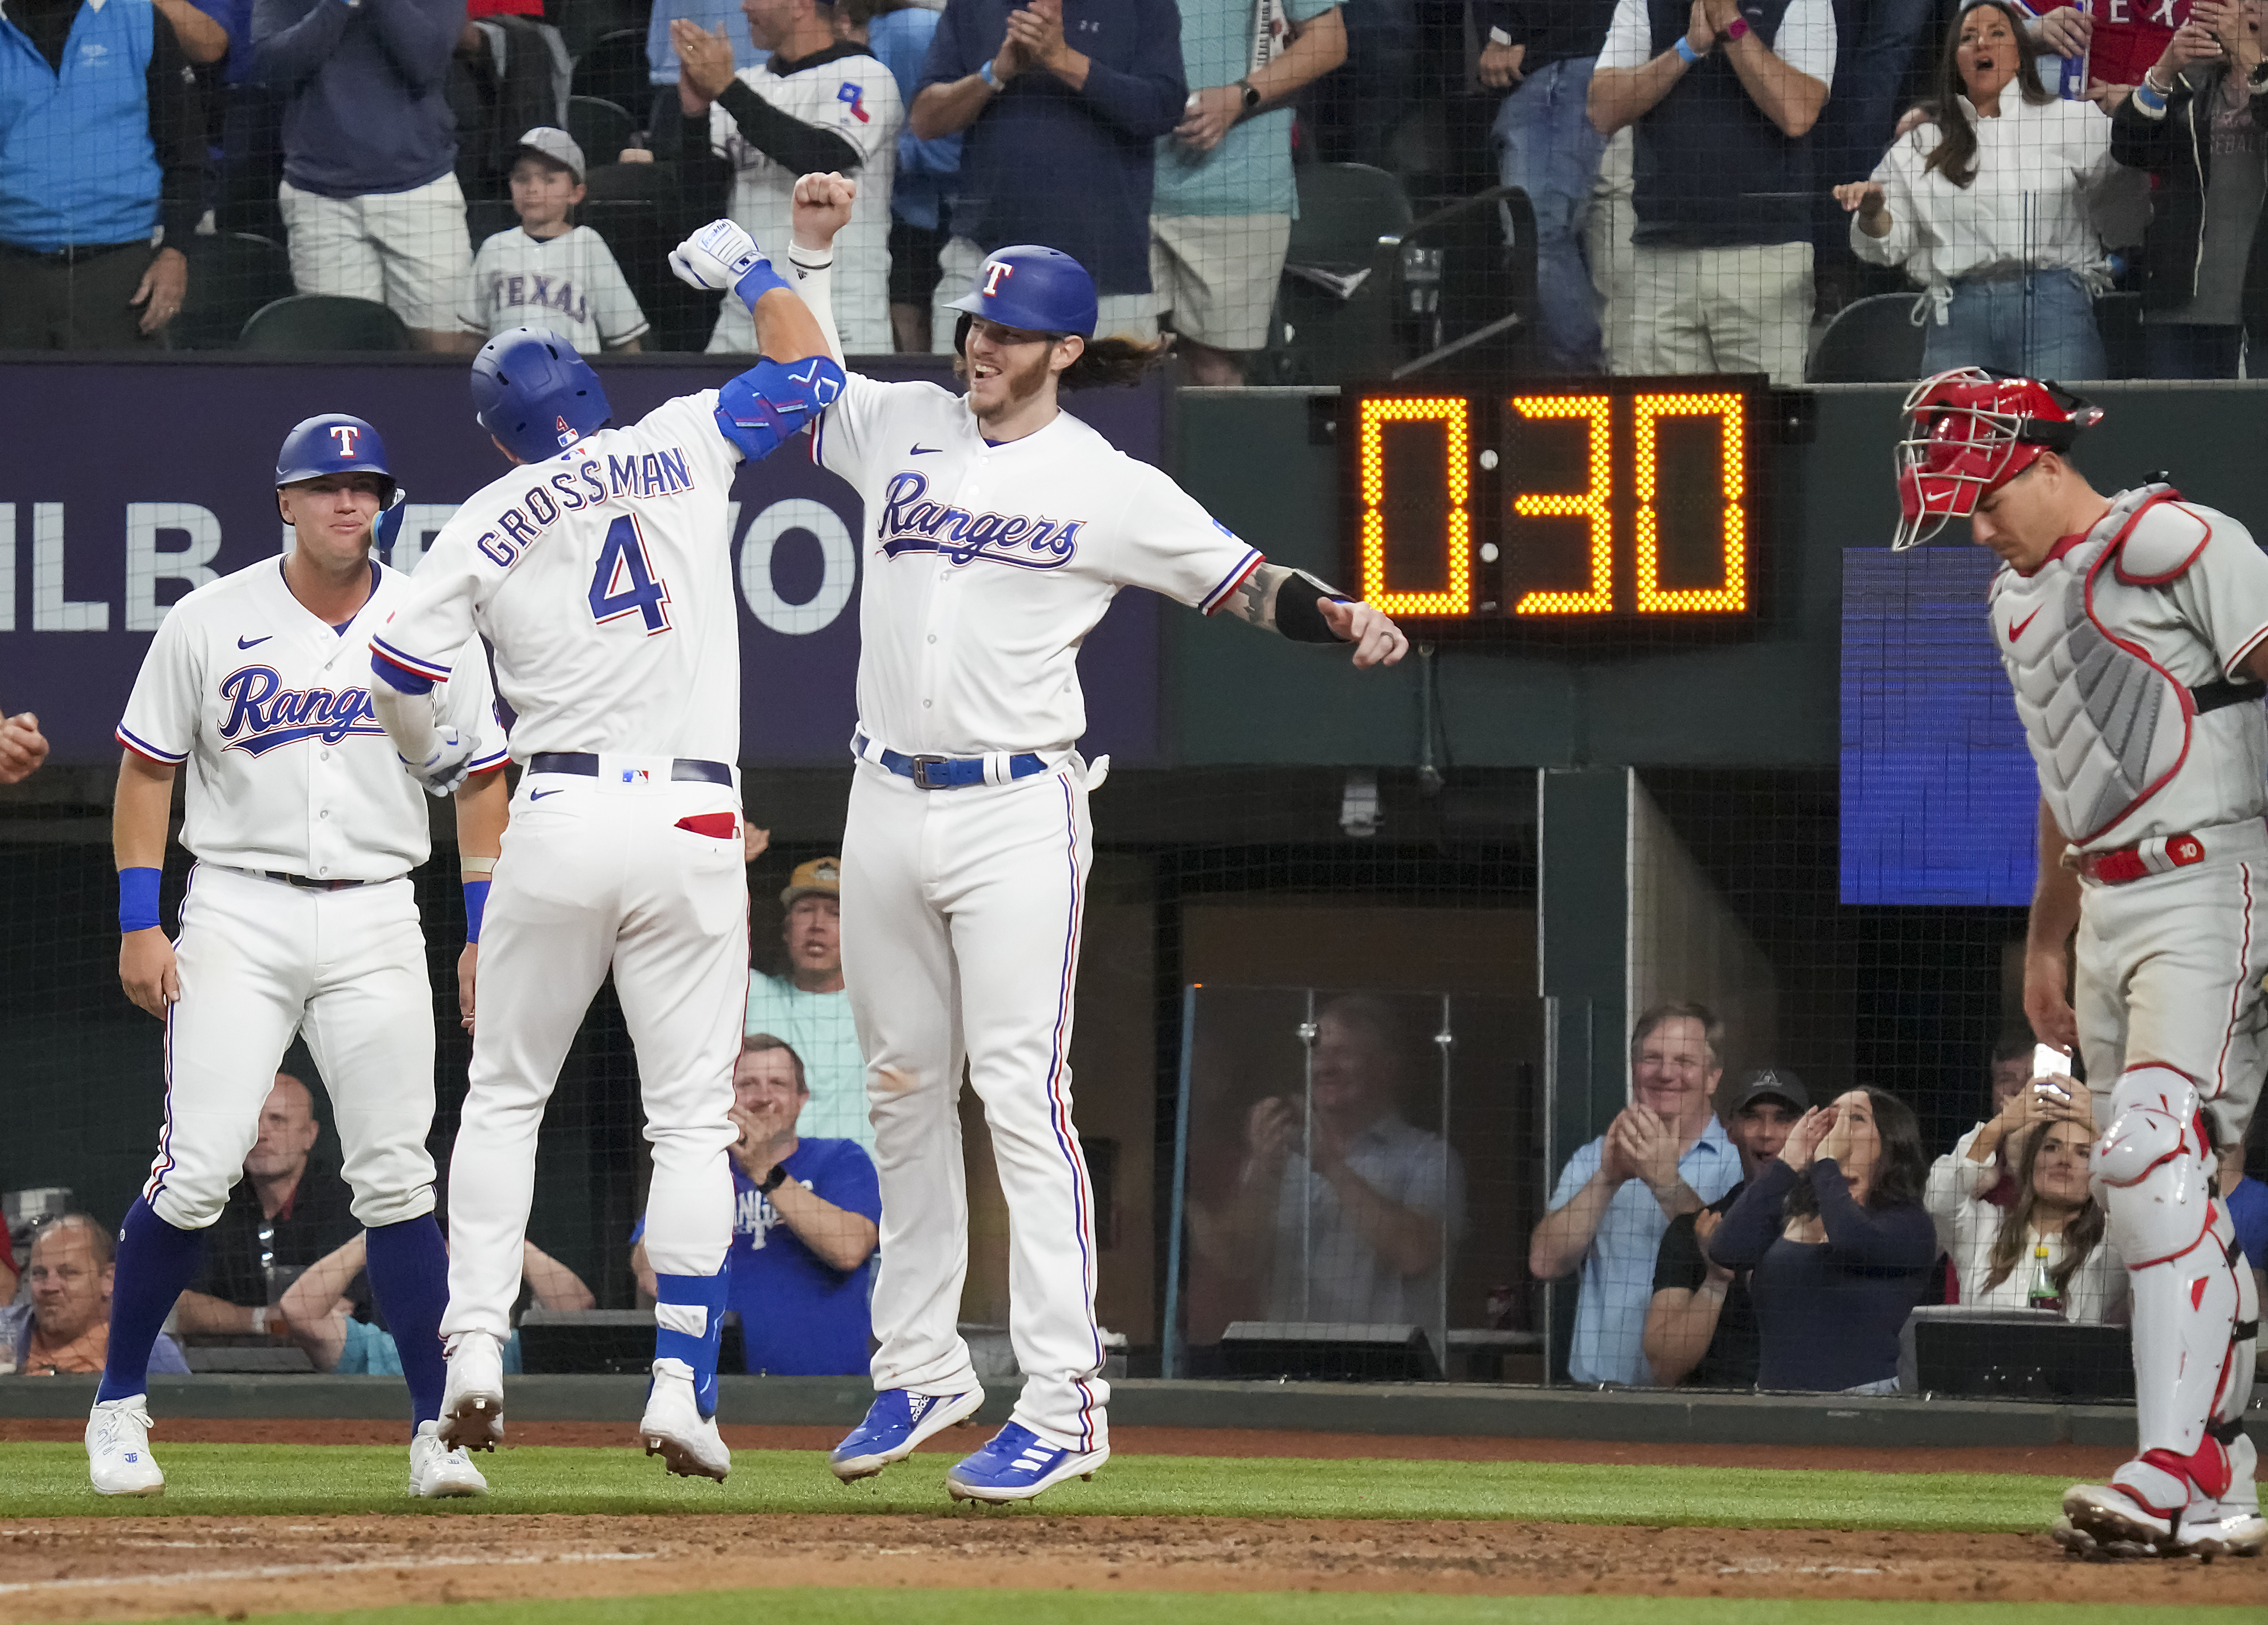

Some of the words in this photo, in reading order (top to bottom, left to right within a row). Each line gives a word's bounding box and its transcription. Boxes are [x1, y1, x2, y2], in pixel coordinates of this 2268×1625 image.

[983, 260, 1014, 297] T
[556, 415, 569, 431] 4
[329, 426, 361, 459] T
[477, 445, 695, 569] GROSSMAN
[874, 469, 1087, 571] Rangers
[588, 512, 672, 637] 4
[2179, 842, 2197, 859] 10
[912, 1395, 931, 1422] adida
